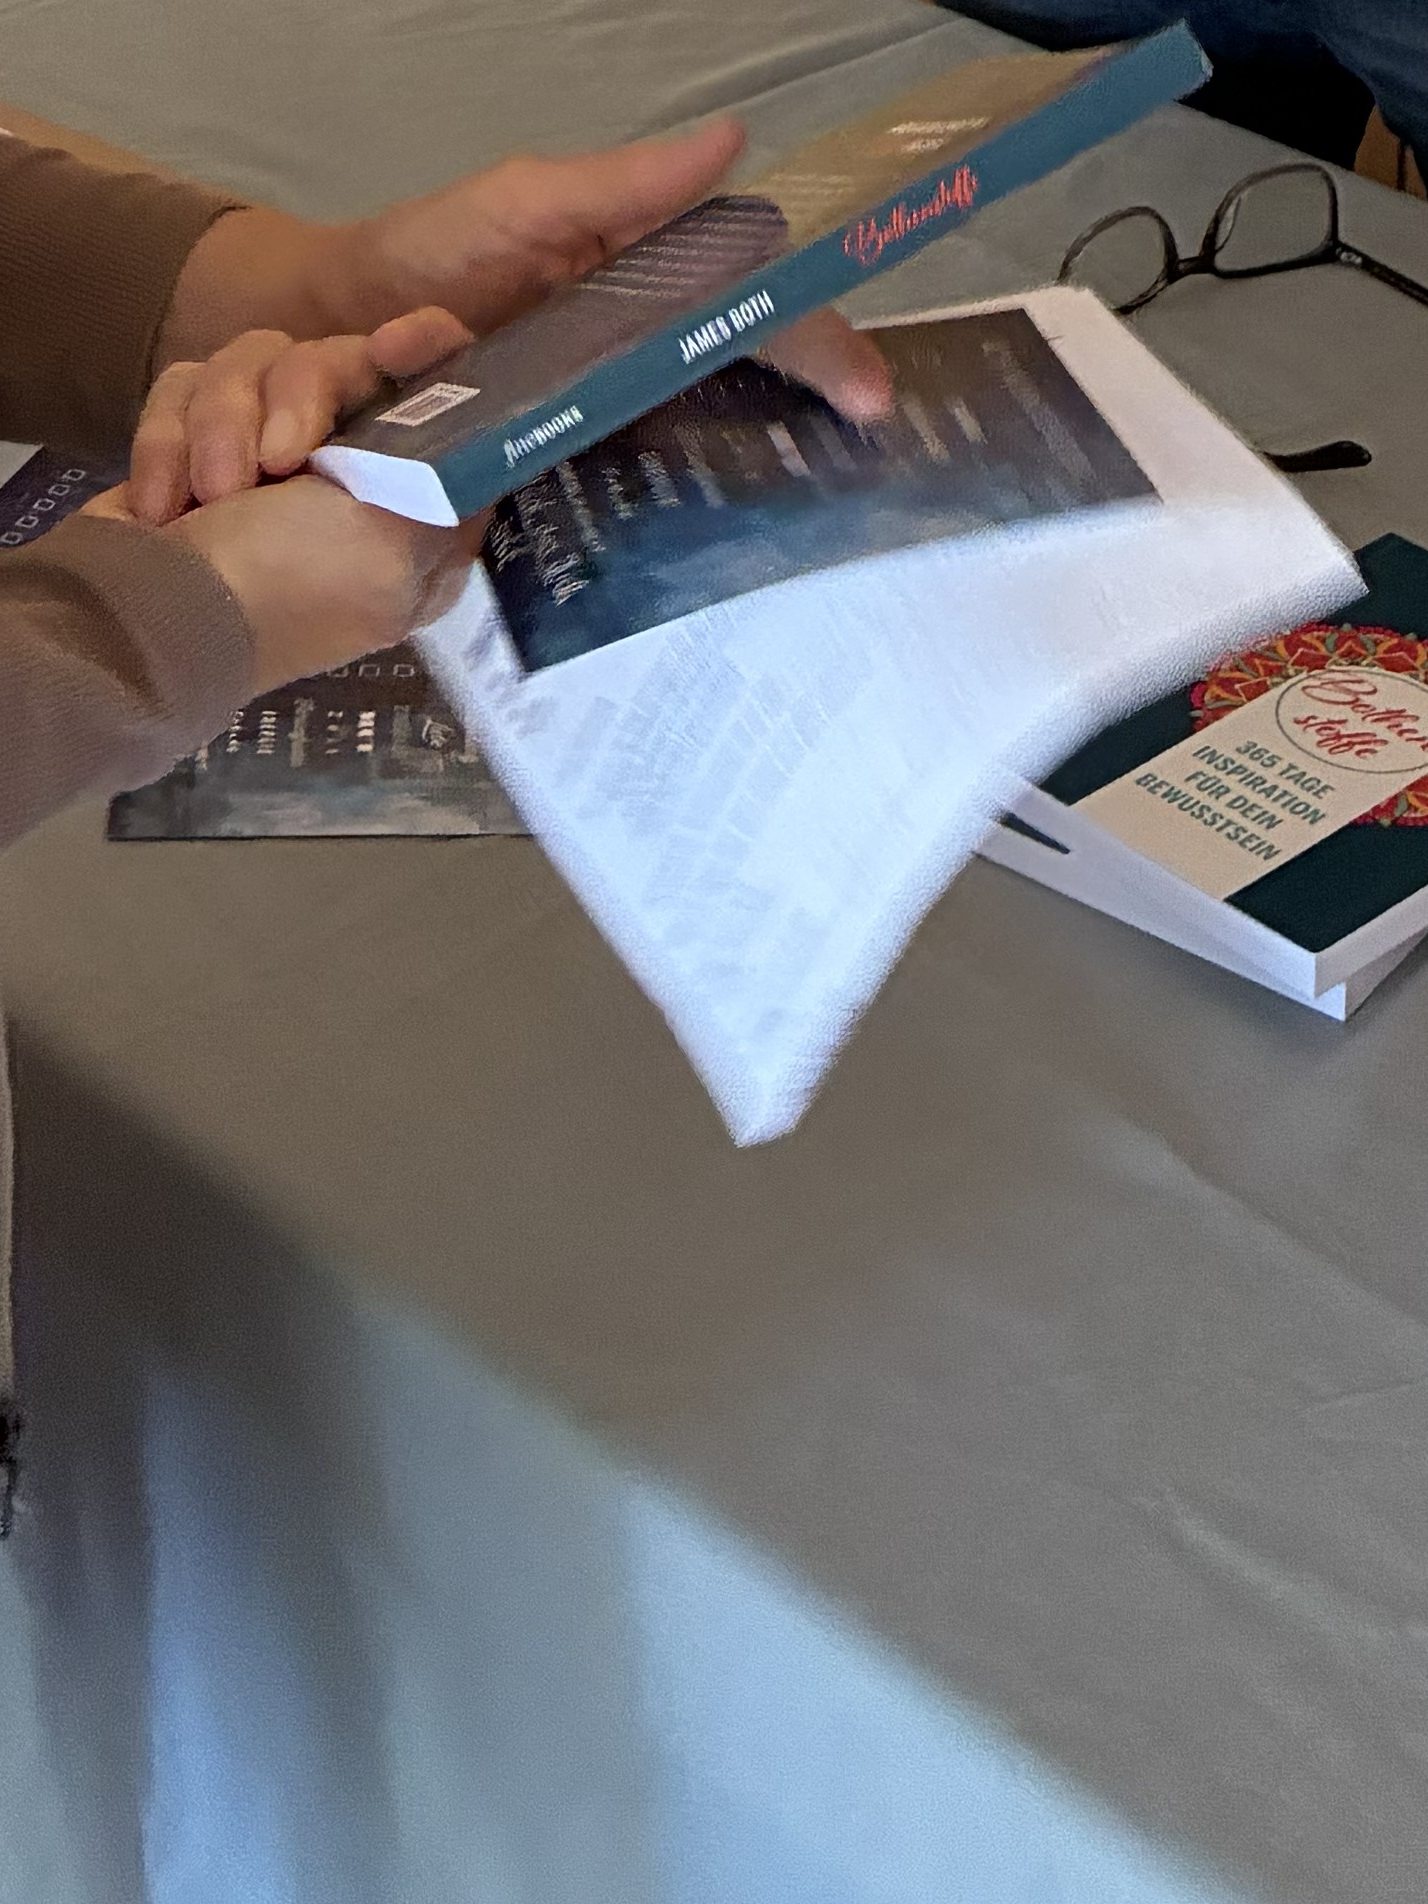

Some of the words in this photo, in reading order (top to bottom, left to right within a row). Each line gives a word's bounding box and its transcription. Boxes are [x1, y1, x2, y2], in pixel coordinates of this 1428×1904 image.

[678, 316, 732, 365] JAMES
[728, 290, 775, 332] BOTH
[1235, 740, 1279, 767] 365
[1280, 759, 1335, 800] TAGE
[1292, 713, 1390, 761] stoffe
[1134, 772, 1283, 862] BEWUSSTSEIN
[1184, 770, 1230, 799] FÜR
[1225, 792, 1284, 830] DEIN
[1192, 746, 1327, 826] INSPIRATION
